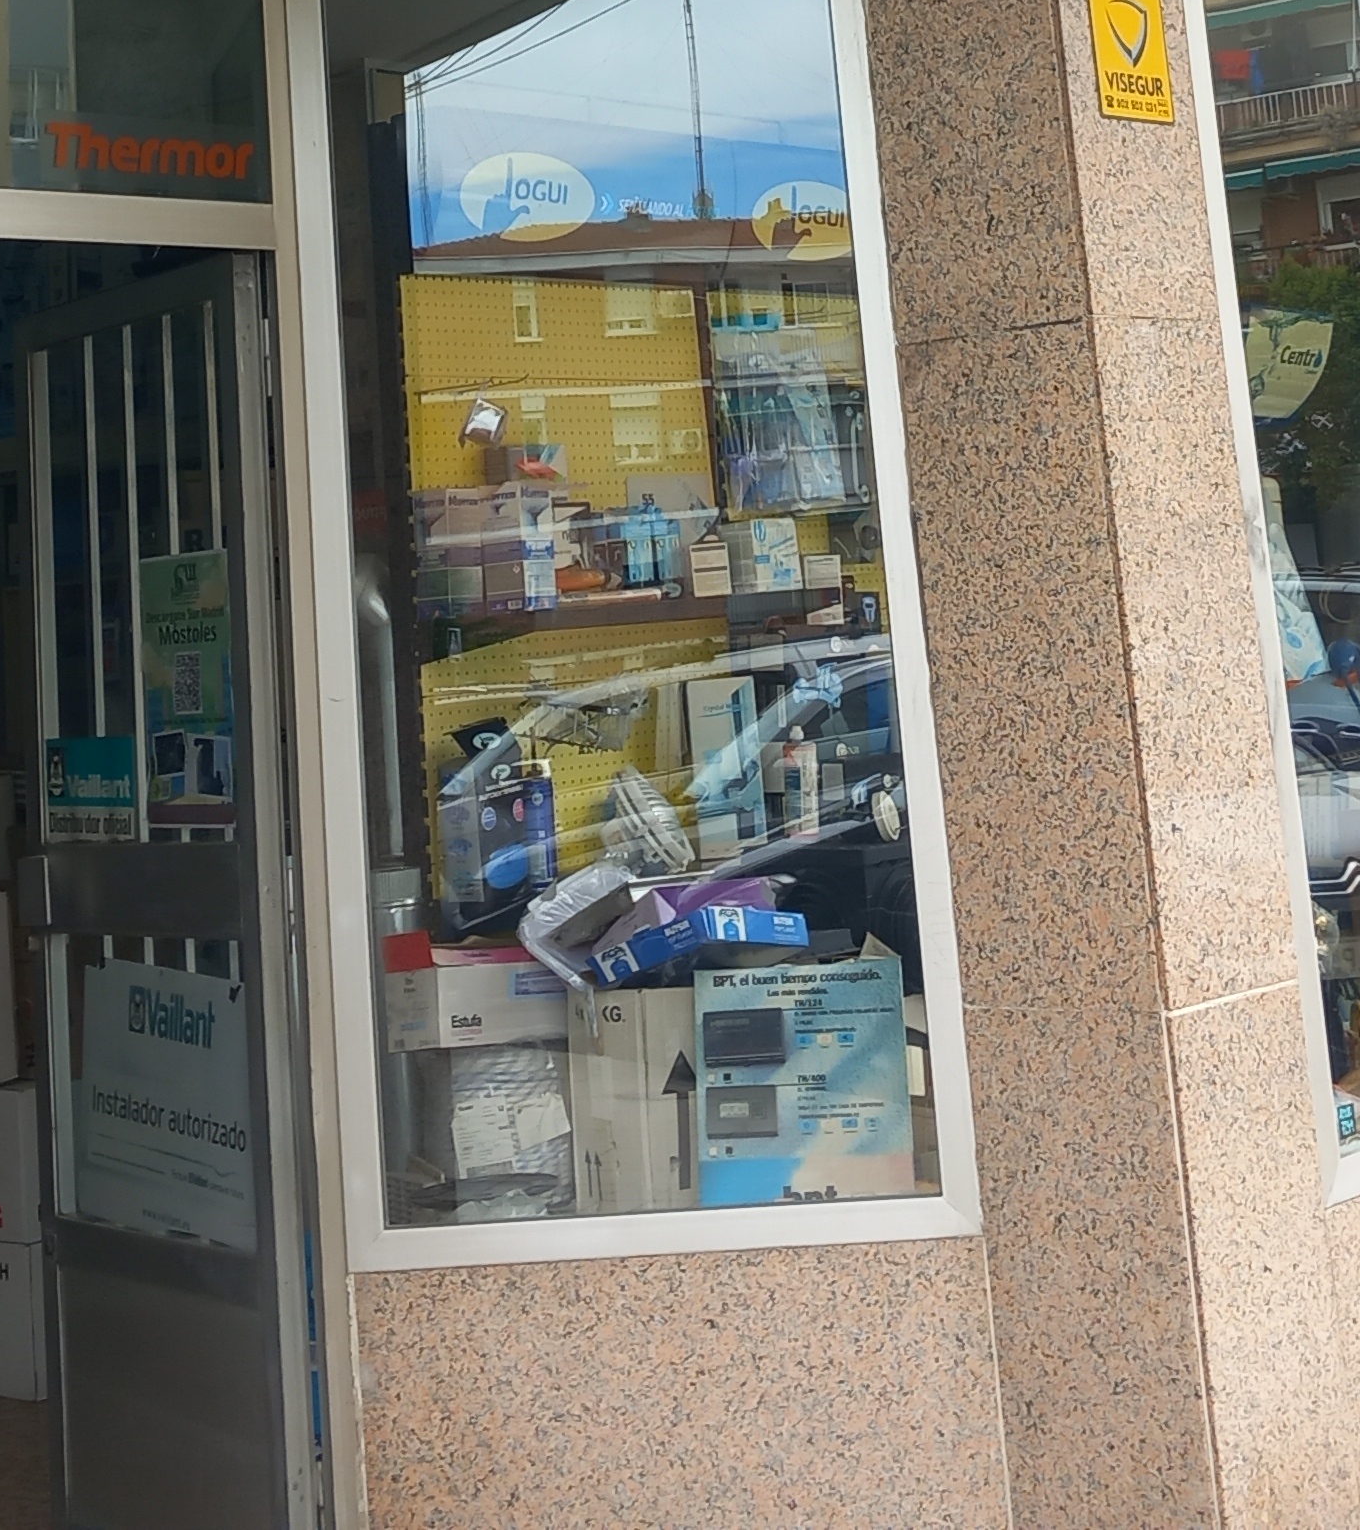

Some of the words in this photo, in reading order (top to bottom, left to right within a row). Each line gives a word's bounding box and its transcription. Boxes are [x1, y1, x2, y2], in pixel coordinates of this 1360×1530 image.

[1105, 70, 1165, 98] VISEGUR
[44, 121, 254, 180] Thermor
[157, 620, 218, 646] Móstoles
[65, 773, 131, 799] Vaillant
[751, 972, 779, 986] buen
[780, 971, 818, 987] tiempo
[145, 987, 216, 1050] Vaillant
[450, 1013, 483, 1029] Estufa
[91, 1084, 165, 1129] Instalador
[168, 1108, 248, 1153] autorizado
